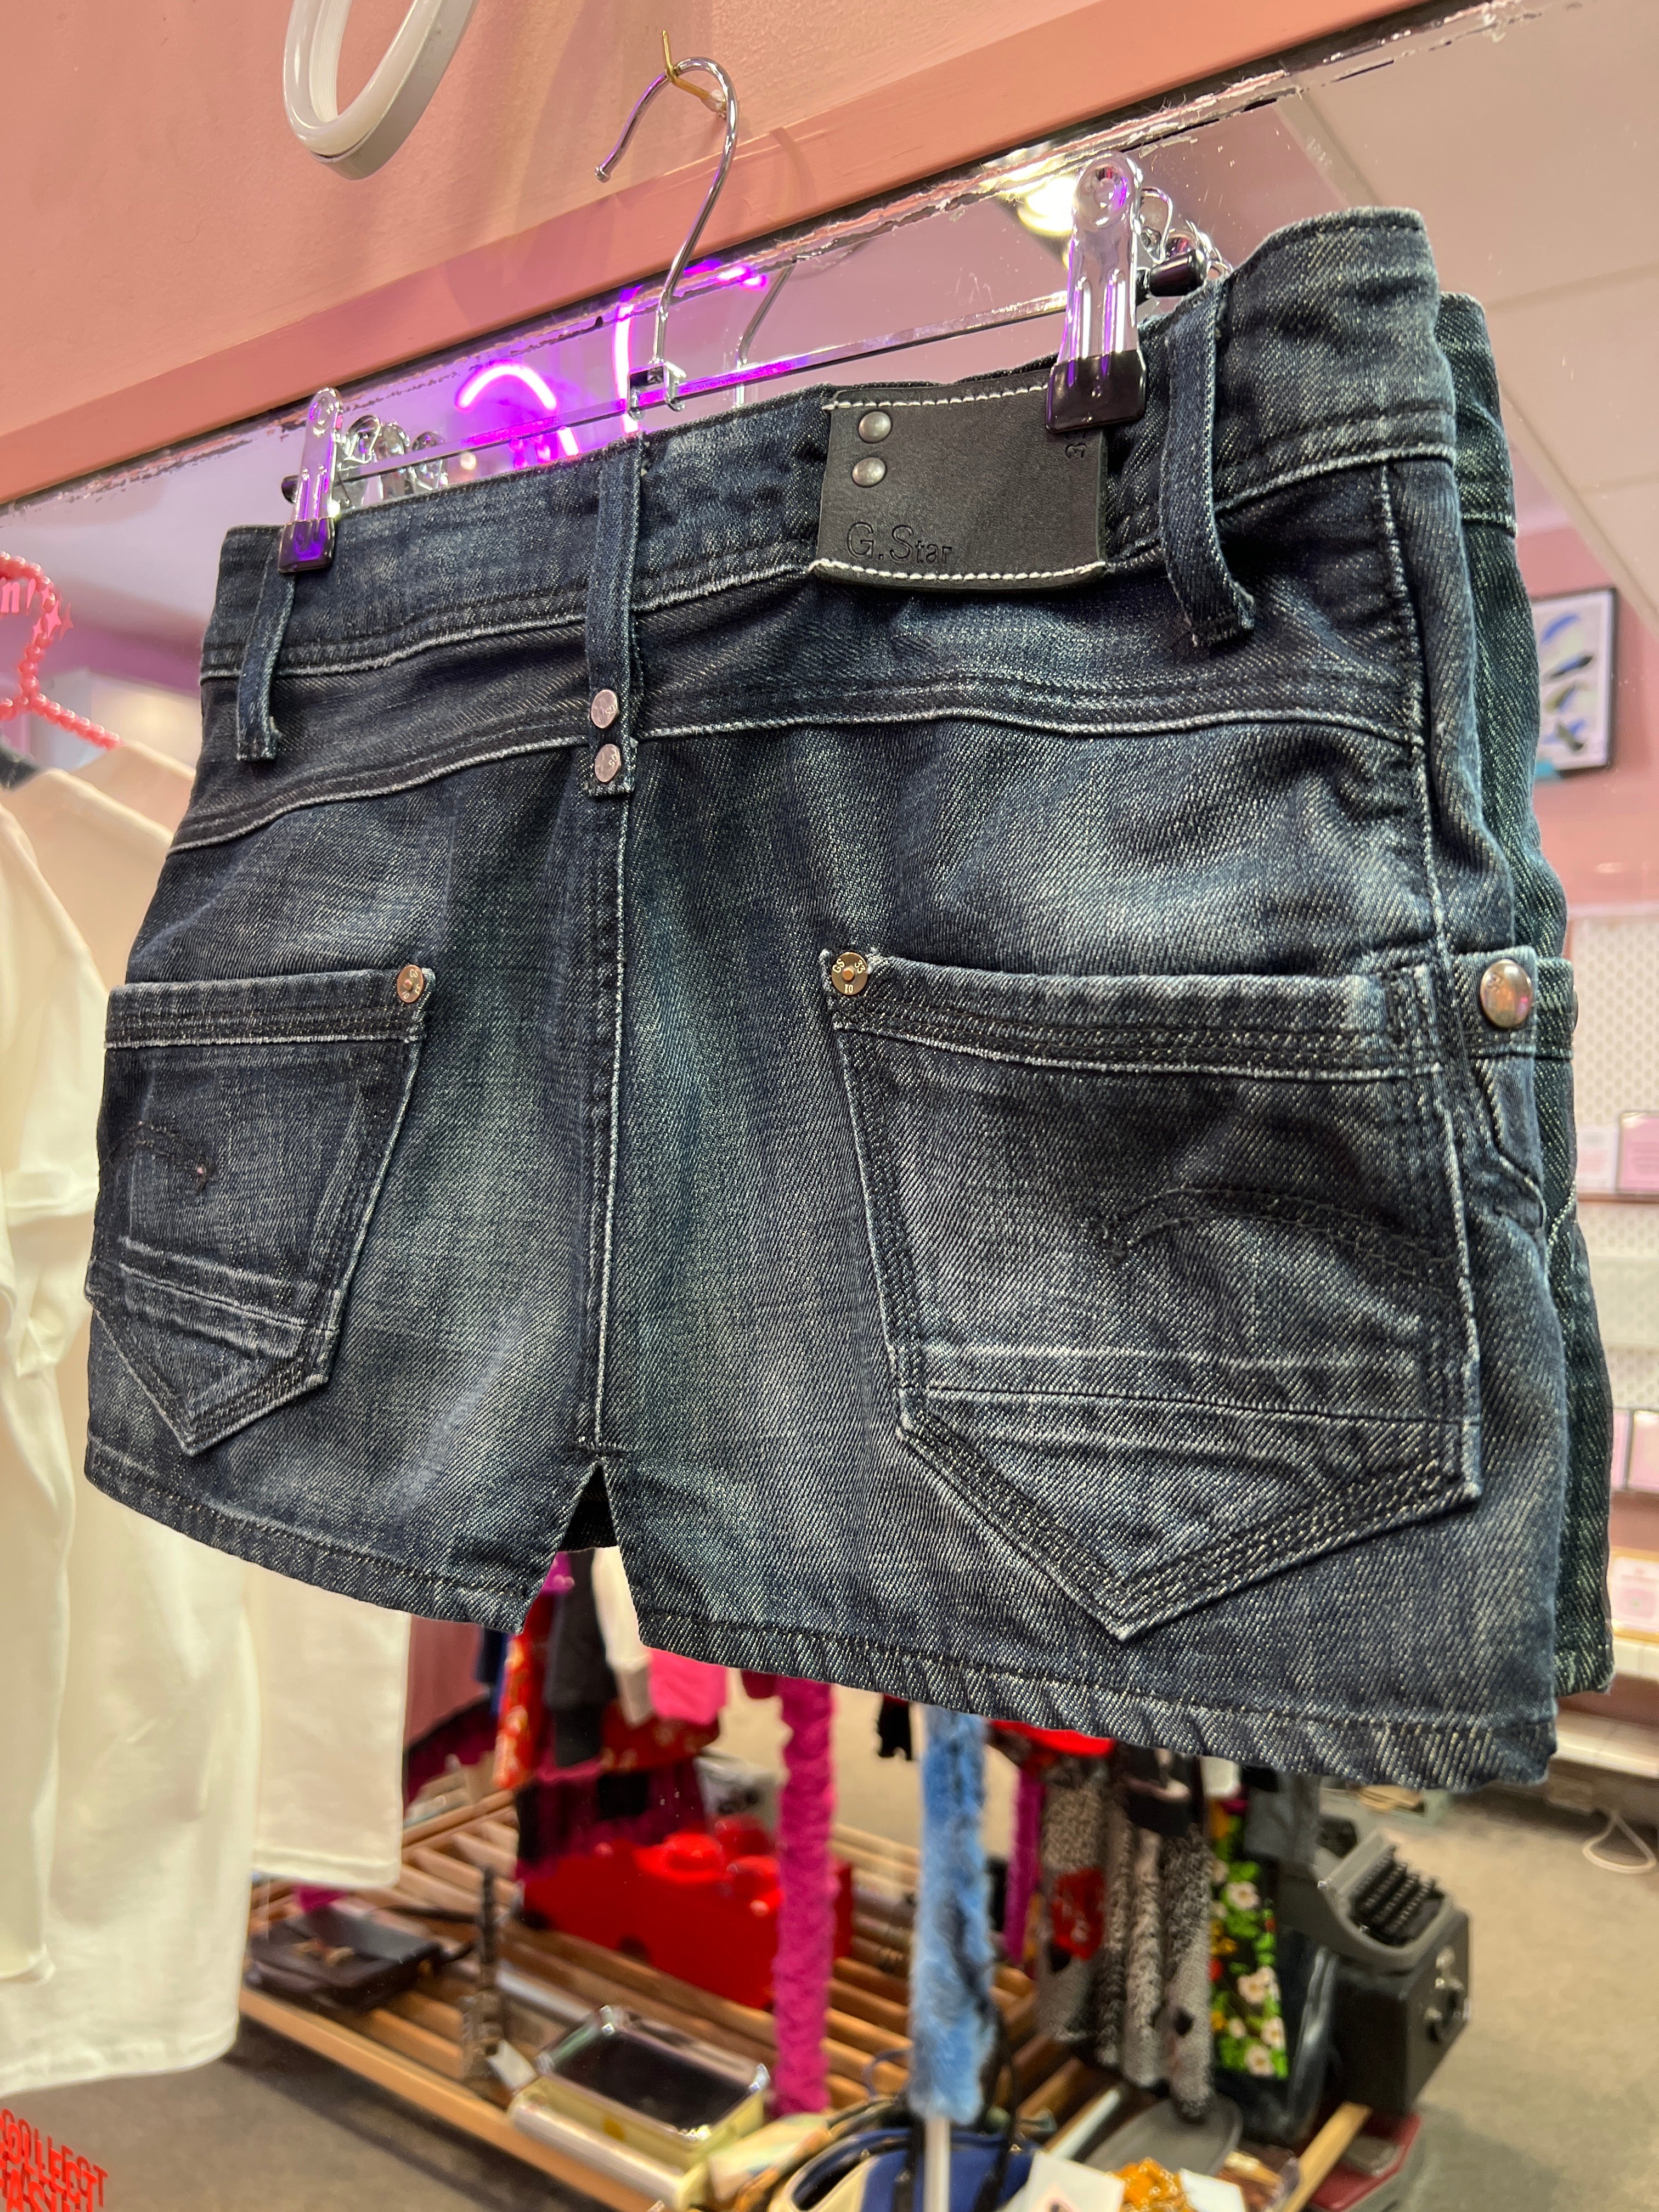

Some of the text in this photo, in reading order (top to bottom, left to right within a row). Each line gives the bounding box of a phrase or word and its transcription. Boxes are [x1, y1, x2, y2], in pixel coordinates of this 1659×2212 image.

[846, 521, 952, 565] G.Star
[832, 958, 845, 973] GS
[854, 959, 866, 974] 33
